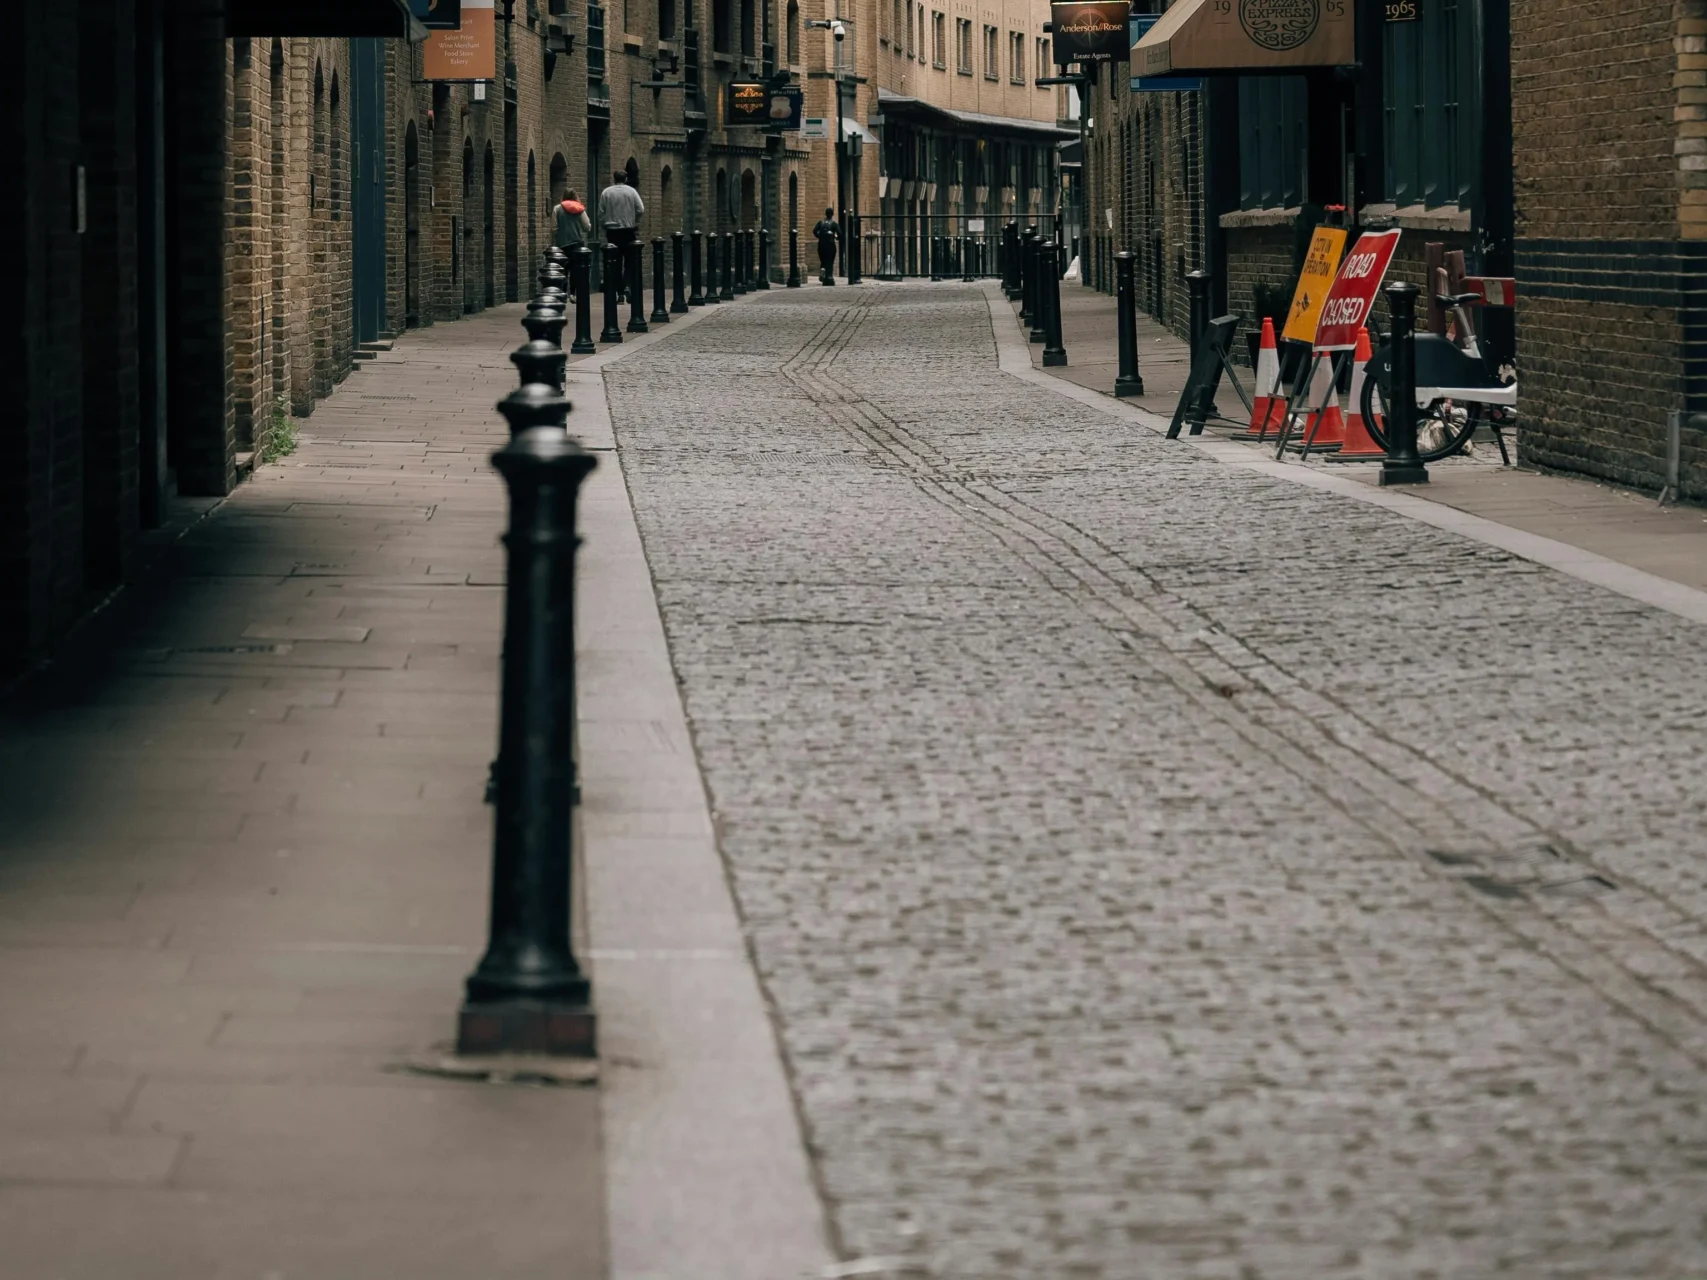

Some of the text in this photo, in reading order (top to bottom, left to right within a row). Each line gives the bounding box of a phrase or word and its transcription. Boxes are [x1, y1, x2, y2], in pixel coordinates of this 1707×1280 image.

[1214, 0, 1231, 15] 19
[1248, 7, 1312, 19] EXPRESS
[1385, 0, 1416, 19] 1965
[450, 58, 469, 66] Bakery
[1091, 52, 1111, 61] Agents
[1342, 253, 1377, 279] ROAD
[1321, 297, 1365, 327] CLOSED
